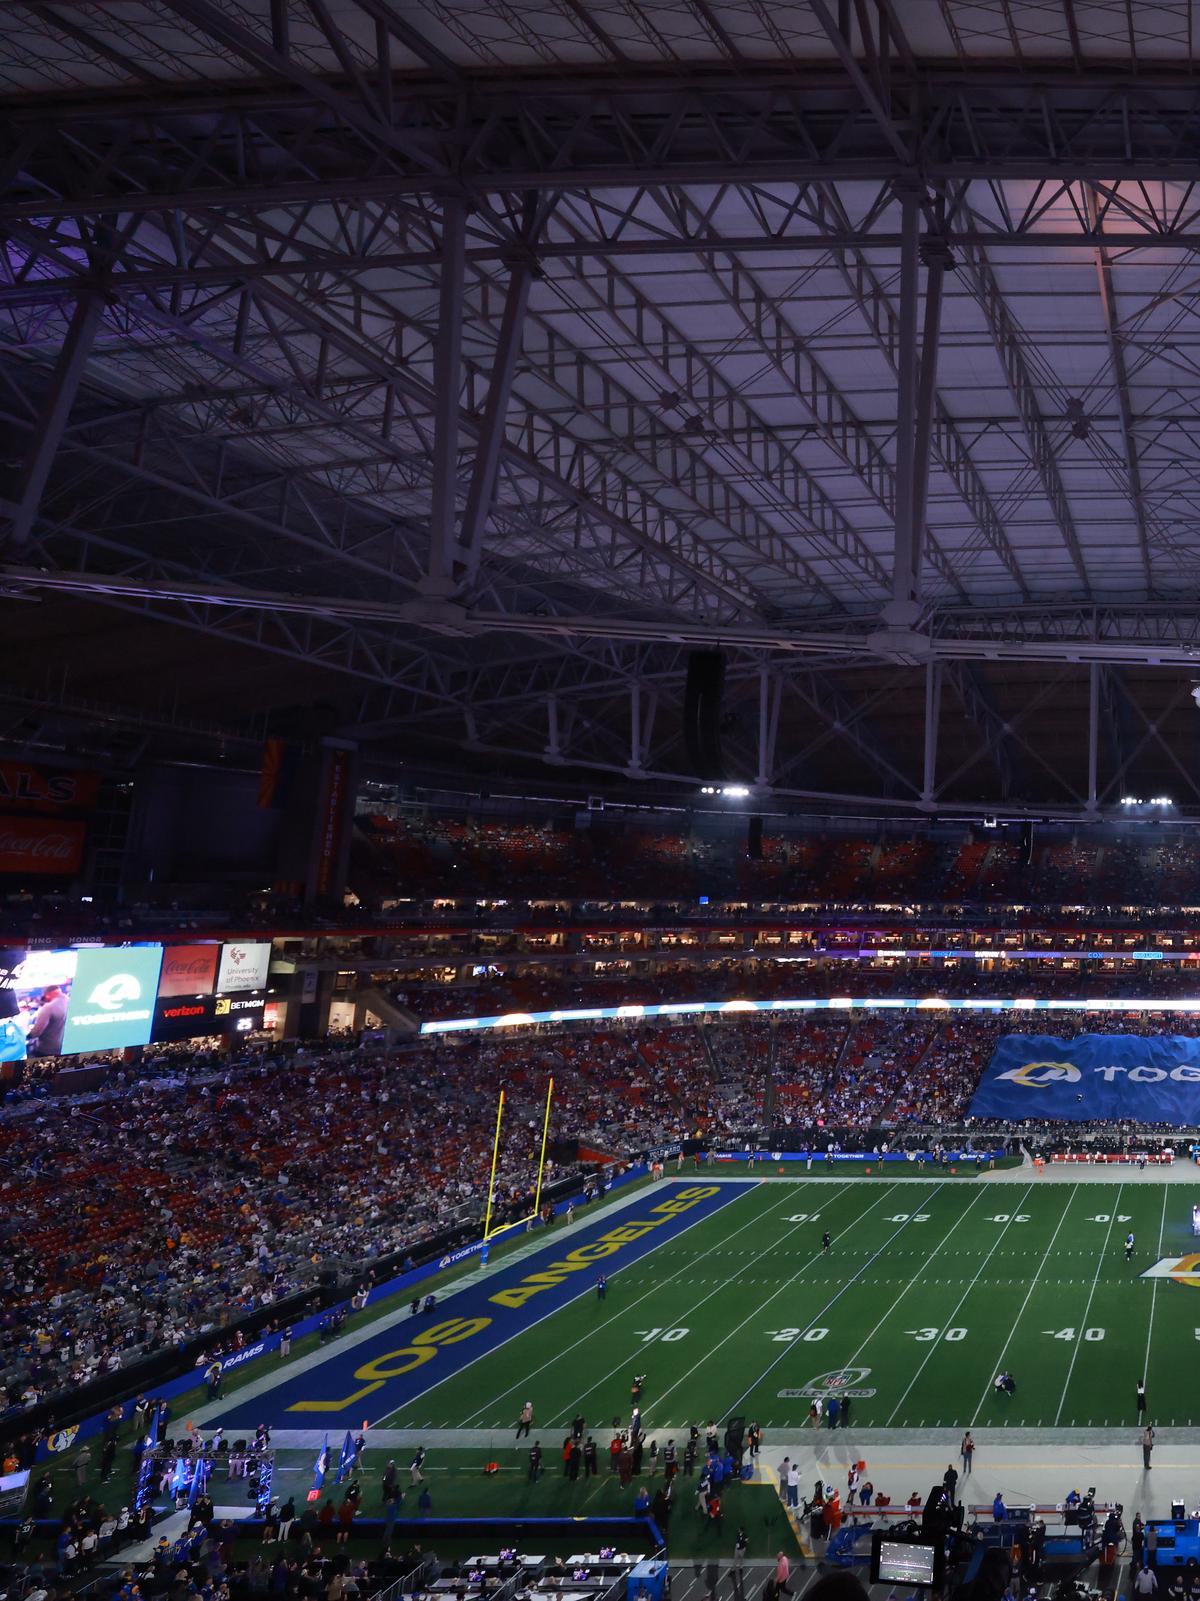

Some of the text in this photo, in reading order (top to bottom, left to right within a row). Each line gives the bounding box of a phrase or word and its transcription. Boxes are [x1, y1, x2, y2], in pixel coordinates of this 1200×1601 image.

[227, 966, 259, 976] University
[234, 974, 260, 983] Phoenix
[163, 1005, 205, 1018] verizon
[230, 1000, 265, 1010] BETMGM
[284, 1317, 493, 1412] LOS
[488, 1186, 721, 1308] ANGELES
[641, 1328, 690, 1341] 10
[771, 1328, 830, 1341] 20
[915, 1328, 968, 1341] 30
[1054, 1328, 1105, 1341] 40
[223, 1344, 265, 1369] RAMS
